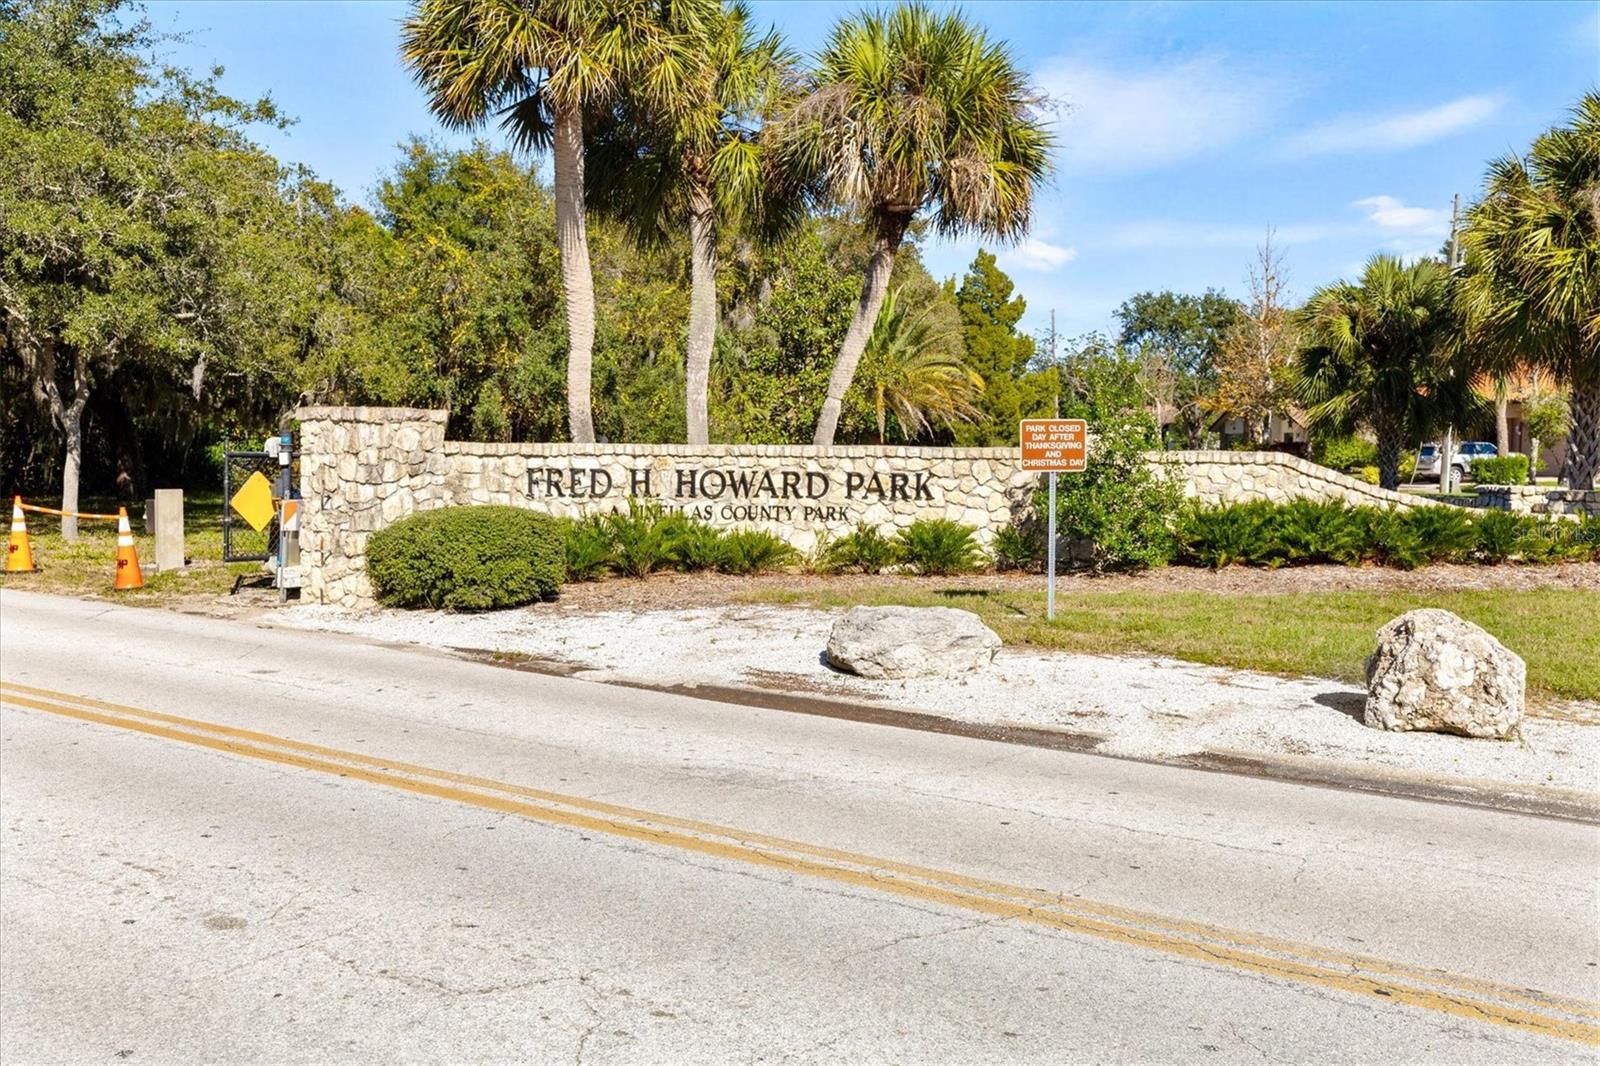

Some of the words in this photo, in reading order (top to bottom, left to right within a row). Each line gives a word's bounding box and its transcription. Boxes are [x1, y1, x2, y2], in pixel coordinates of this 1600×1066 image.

[1025, 424, 1046, 432] PARK
[1048, 424, 1081, 432] CLOSED
[1032, 433, 1047, 441] DAY
[1049, 433, 1075, 441] AFTER
[1045, 450, 1062, 458] AND
[1022, 459, 1067, 467] CHRISTMAS
[526, 468, 612, 498] FRED
[629, 468, 661, 499] H.
[676, 469, 830, 500] HOWARD
[845, 470, 936, 501] PARK
[720, 505, 796, 521] COUNTY
[803, 505, 851, 522] PARK
